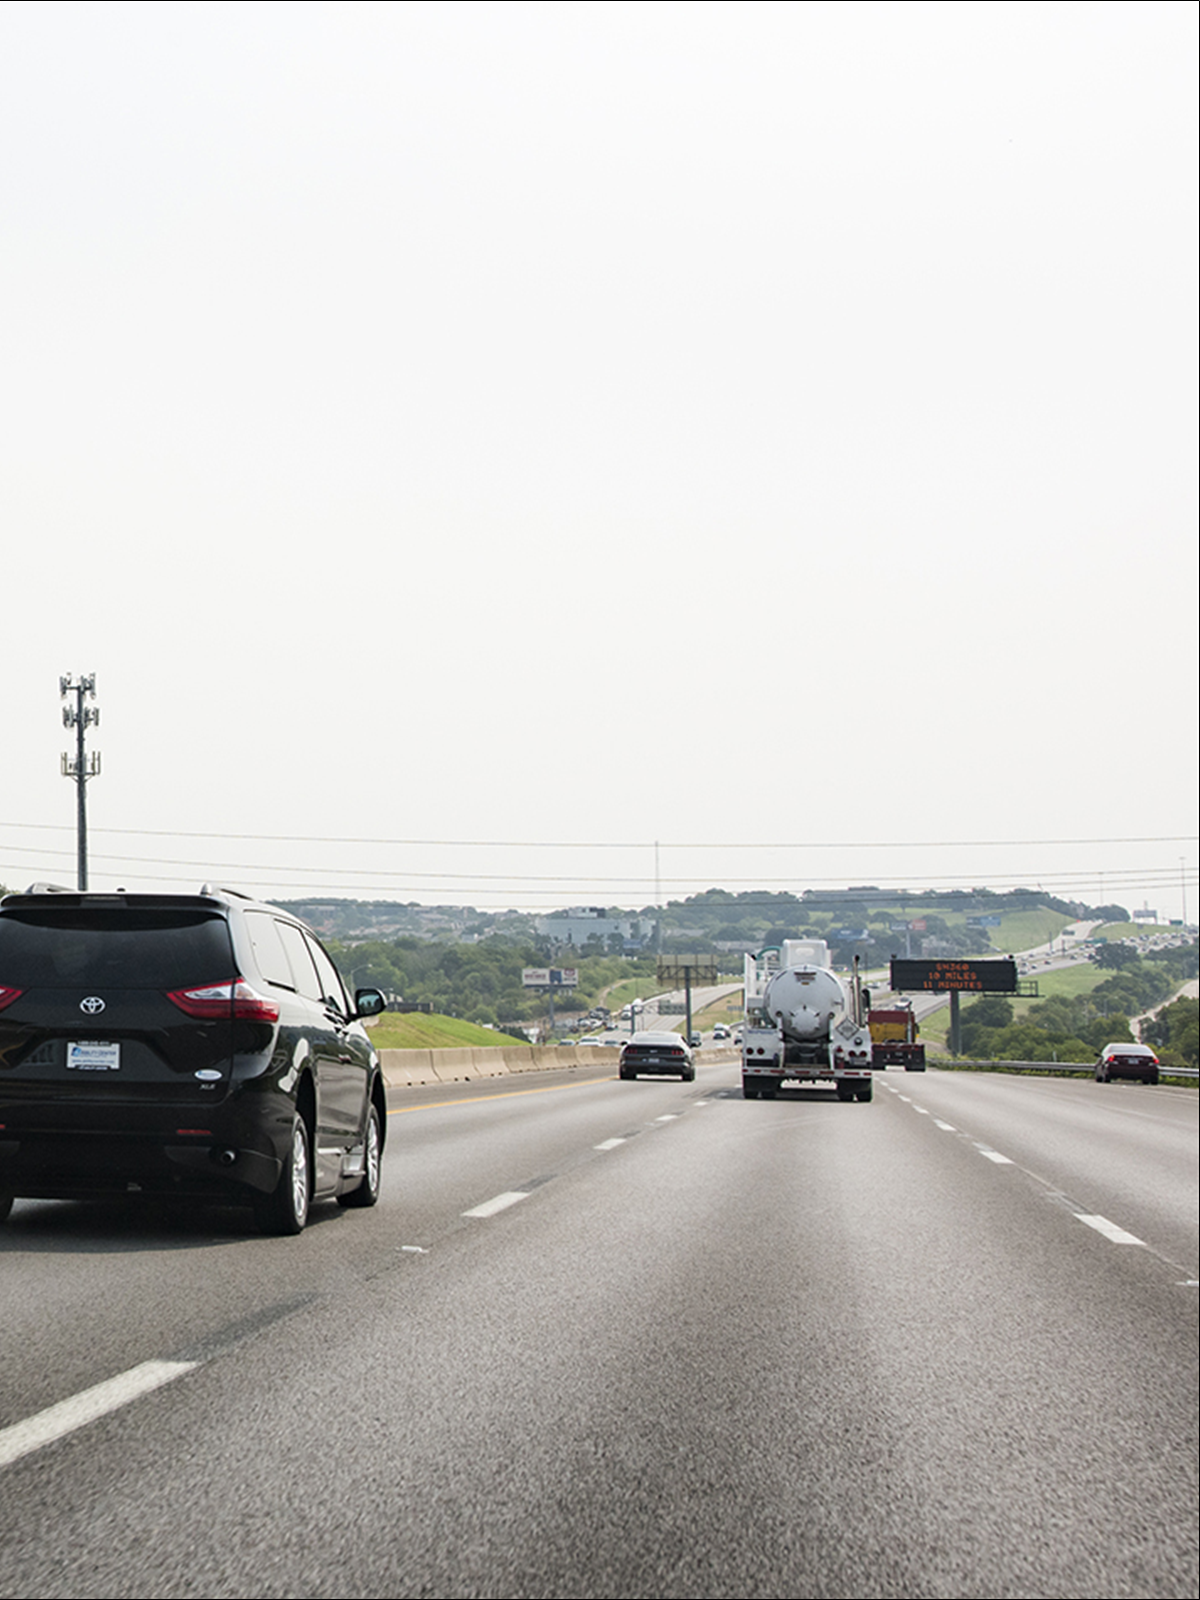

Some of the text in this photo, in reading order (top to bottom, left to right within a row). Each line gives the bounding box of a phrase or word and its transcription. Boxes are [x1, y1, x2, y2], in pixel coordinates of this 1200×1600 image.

[928, 972, 977, 980] 10 MILES
[923, 981, 983, 989] 11 MINUTES
